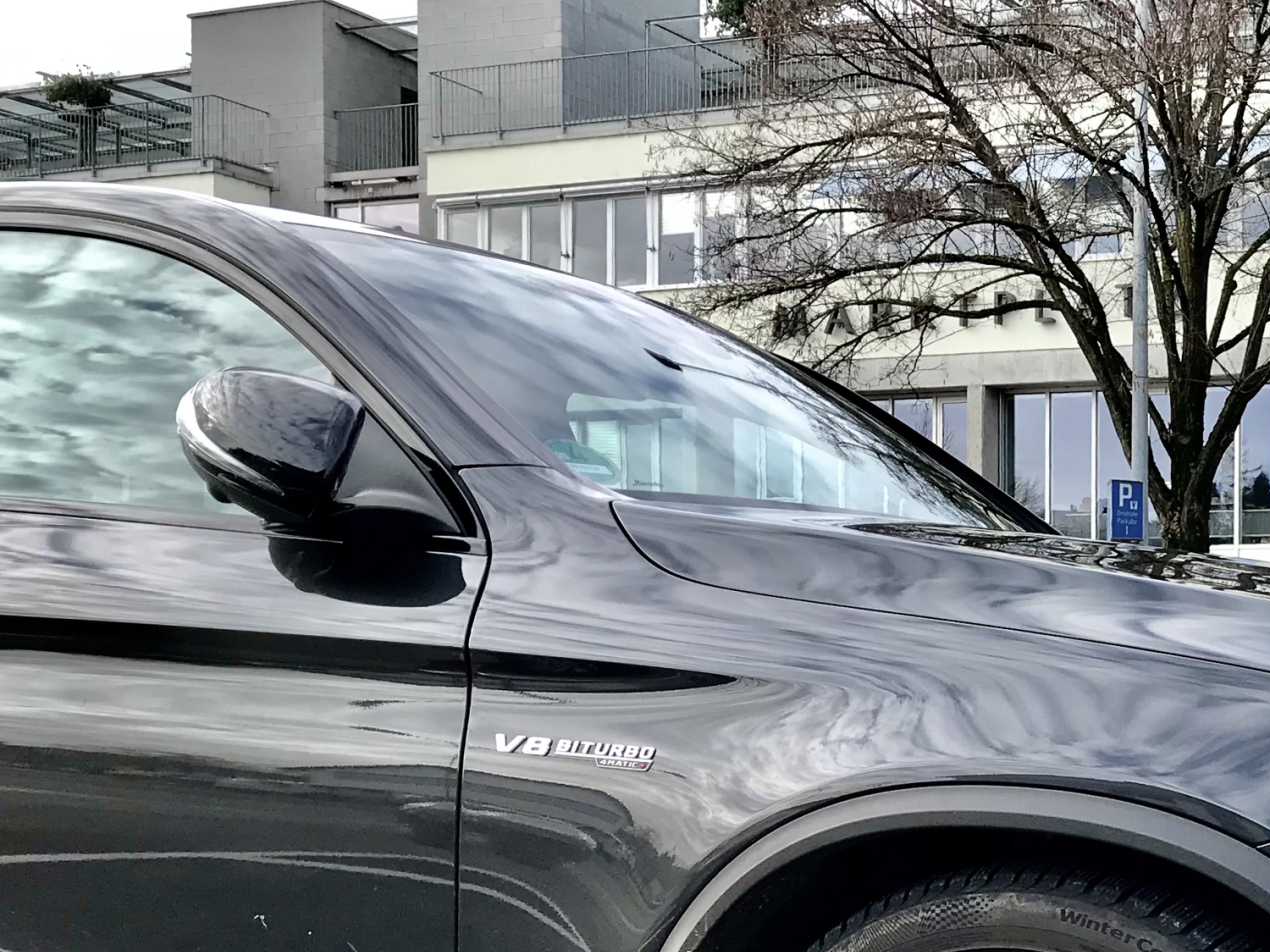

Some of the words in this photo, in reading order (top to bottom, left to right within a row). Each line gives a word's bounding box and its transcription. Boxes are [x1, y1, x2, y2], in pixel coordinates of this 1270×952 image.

[1119, 483, 1132, 507] P
[495, 733, 553, 756] V8
[554, 739, 657, 760] BITURBO
